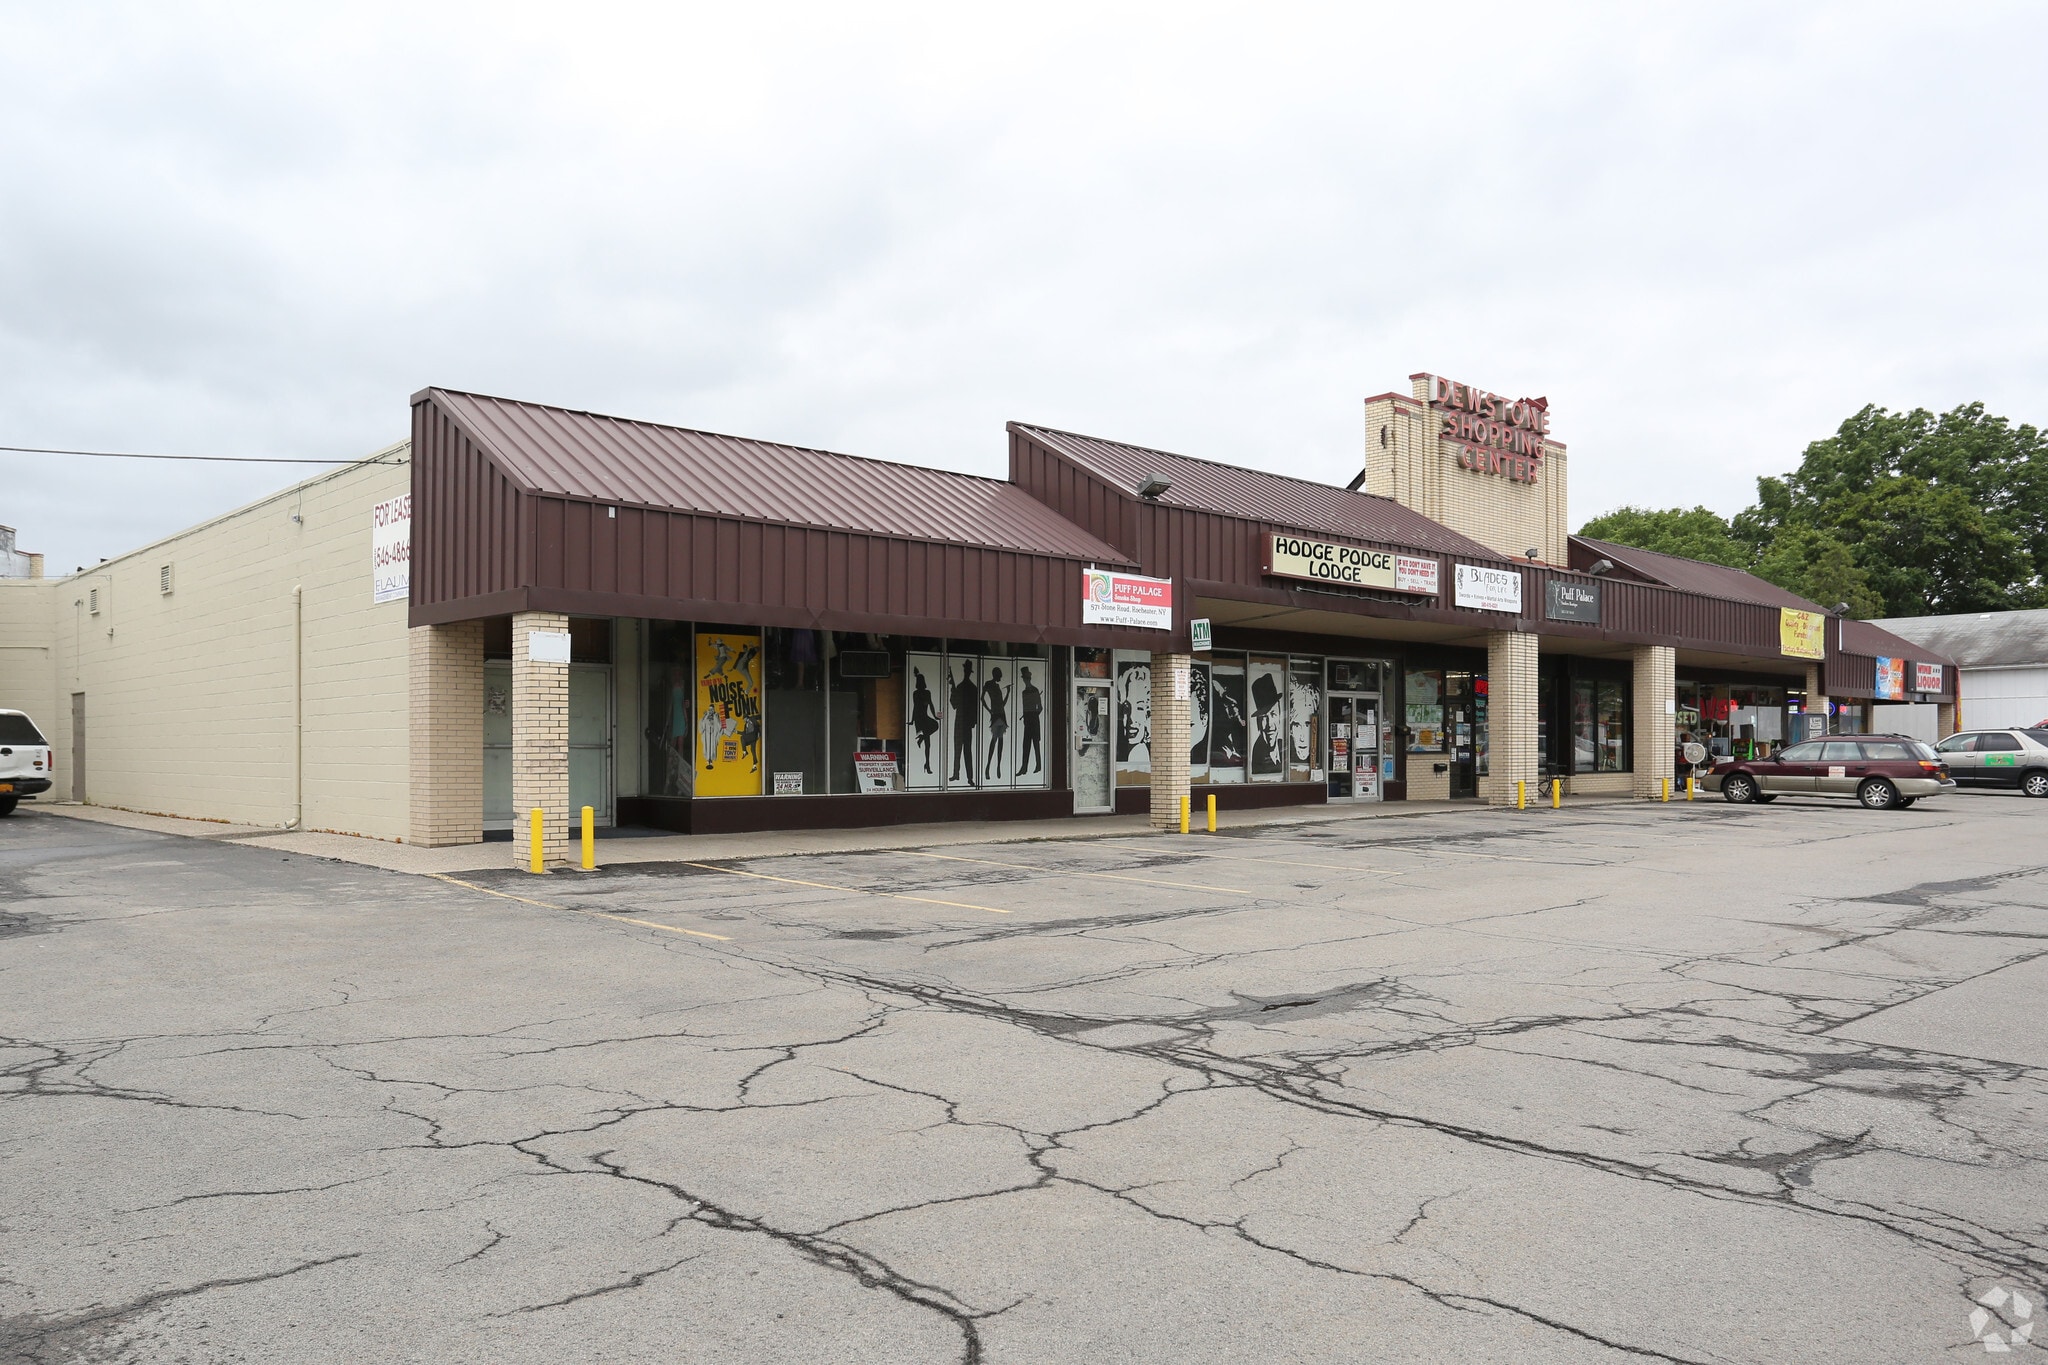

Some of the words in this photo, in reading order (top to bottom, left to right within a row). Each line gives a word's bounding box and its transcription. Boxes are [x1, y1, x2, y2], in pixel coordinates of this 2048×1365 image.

[1432, 376, 1550, 435] DEWSTONE
[1444, 411, 1544, 458] SHOPPING
[1458, 445, 1538, 484] CENTER
[375, 503, 389, 528] FOR
[391, 495, 411, 523] LEASE
[376, 539, 410, 568] 546-4866
[1276, 537, 1333, 562] HODGE
[1340, 548, 1391, 570] PODGE
[1309, 561, 1362, 582] LODGE
[1421, 562, 1431, 570] HAVE
[1470, 568, 1507, 585] BLADES
[1114, 584, 1131, 593] PUFF
[1133, 586, 1162, 597] PALACE
[1561, 587, 1575, 600] Puff
[1576, 589, 1594, 603] Palace
[1101, 603, 1115, 611] Stone
[1193, 622, 1210, 639] ATM
[1918, 664, 1932, 674] WINE
[709, 680, 744, 703] NOISE
[1917, 676, 1940, 688] LIQUOR
[724, 696, 759, 719] FUNK
[1675, 711, 1697, 725] SED
